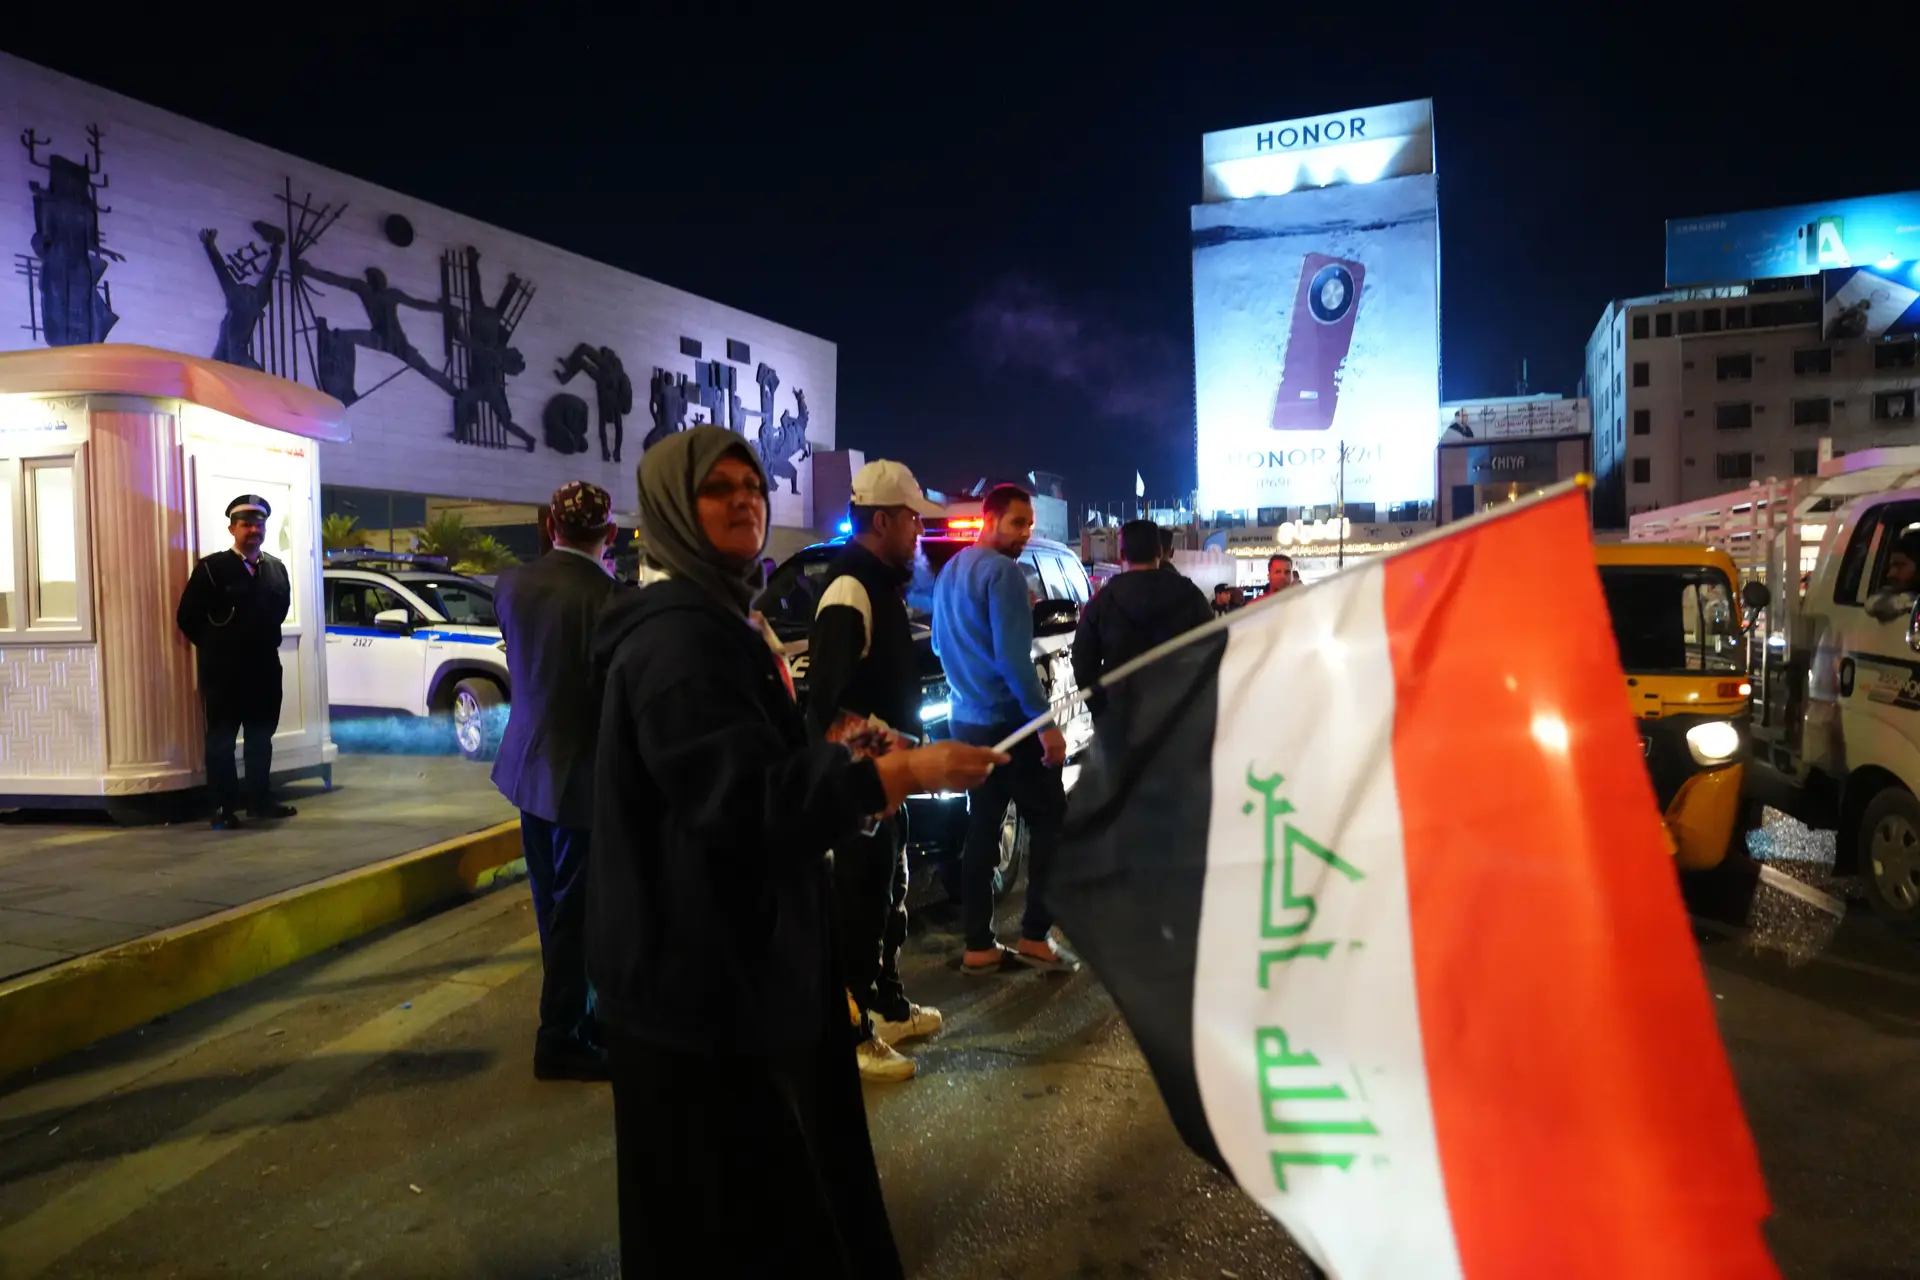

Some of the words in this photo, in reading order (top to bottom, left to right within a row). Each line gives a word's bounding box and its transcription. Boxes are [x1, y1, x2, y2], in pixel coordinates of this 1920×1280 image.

[1257, 117, 1367, 152] HONOR
[1227, 447, 1326, 469] HONOR
[352, 637, 373, 648] 2127
